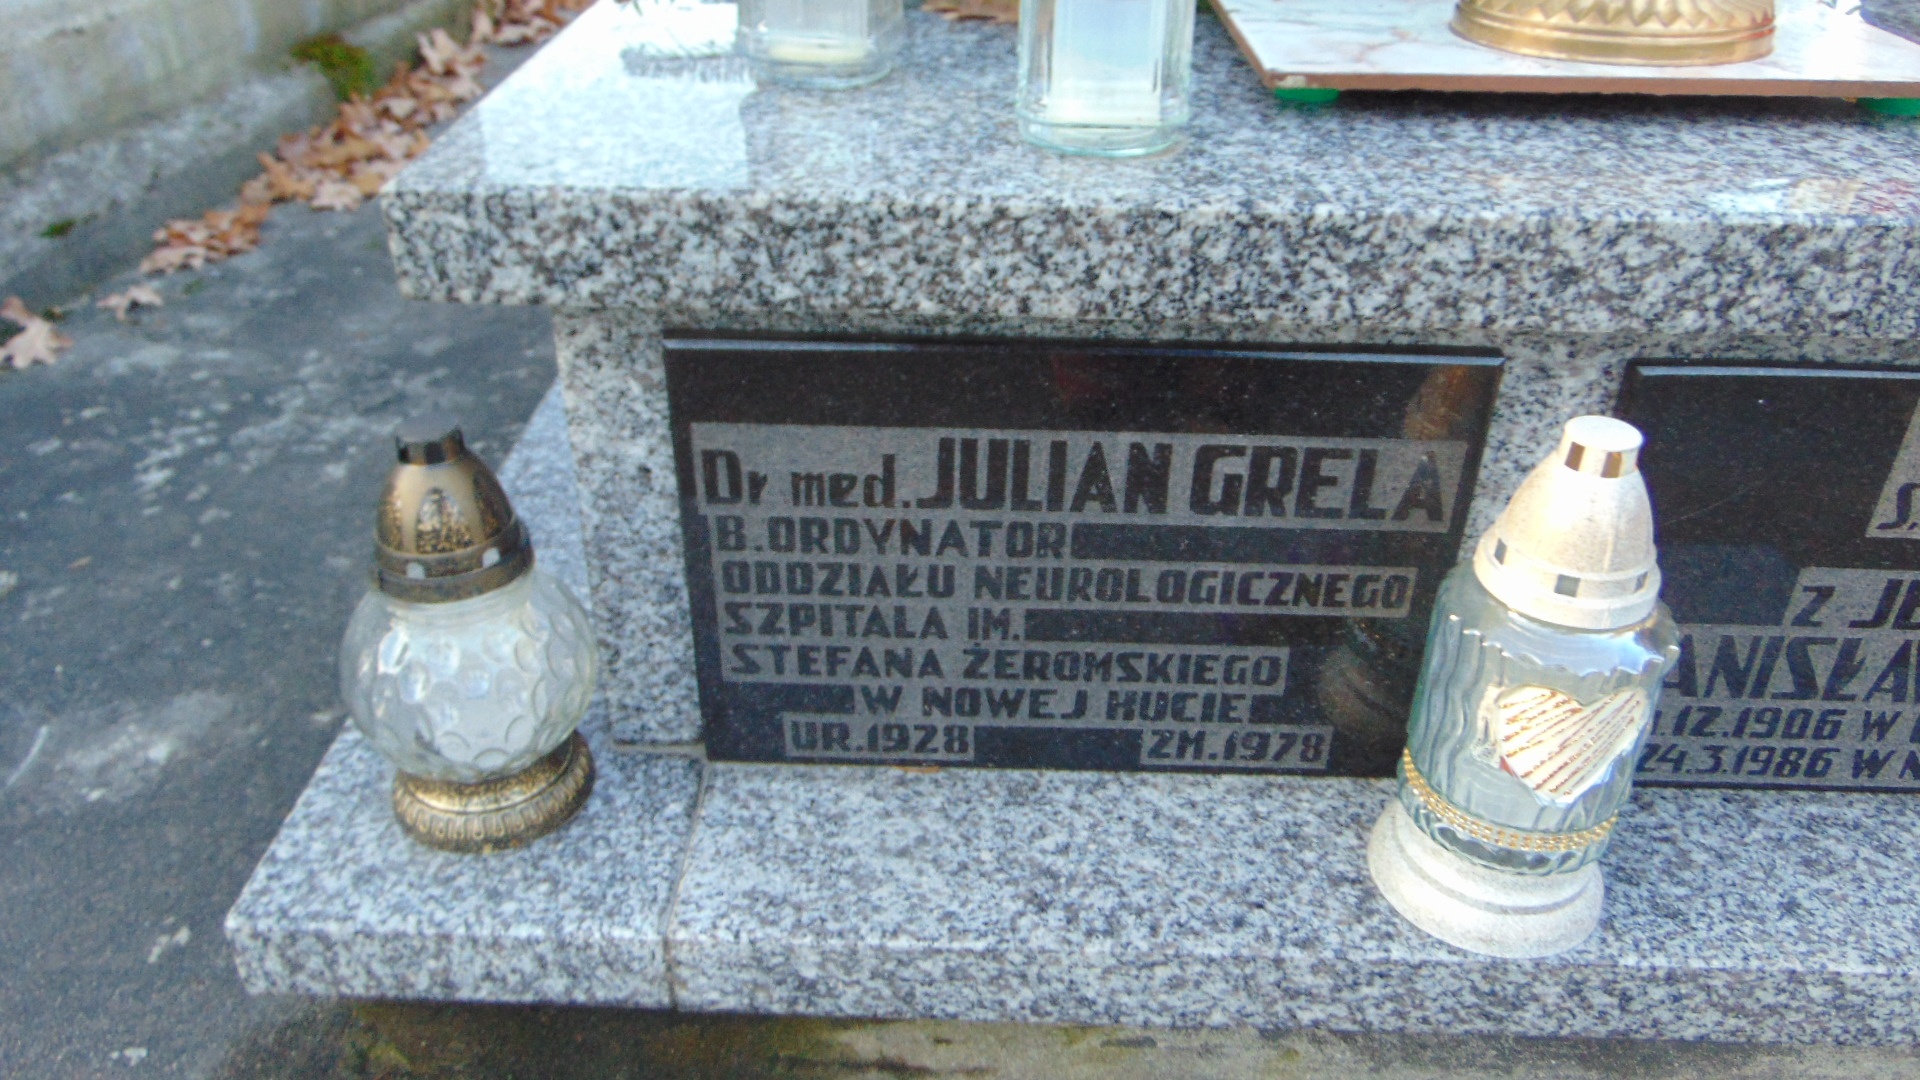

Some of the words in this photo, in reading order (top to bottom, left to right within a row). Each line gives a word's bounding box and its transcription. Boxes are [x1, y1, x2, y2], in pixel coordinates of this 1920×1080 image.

[702, 449, 768, 506] Dr
[1190, 444, 1444, 522] GRELA
[722, 559, 956, 598] ODDZIAŁU
[974, 564, 1411, 609] NEUROLOGICZNEGO
[725, 602, 949, 640] SZPITALA
[968, 607, 1021, 641] IM.
[1791, 586, 1836, 627] Z
[731, 643, 946, 679] STEFANA
[963, 642, 1283, 687] ŻEROMSKIEGO
[861, 685, 903, 717] W
[922, 686, 1089, 719] NOWEJ
[1106, 690, 1248, 724] HUCIE
[1861, 710, 1903, 742] W
